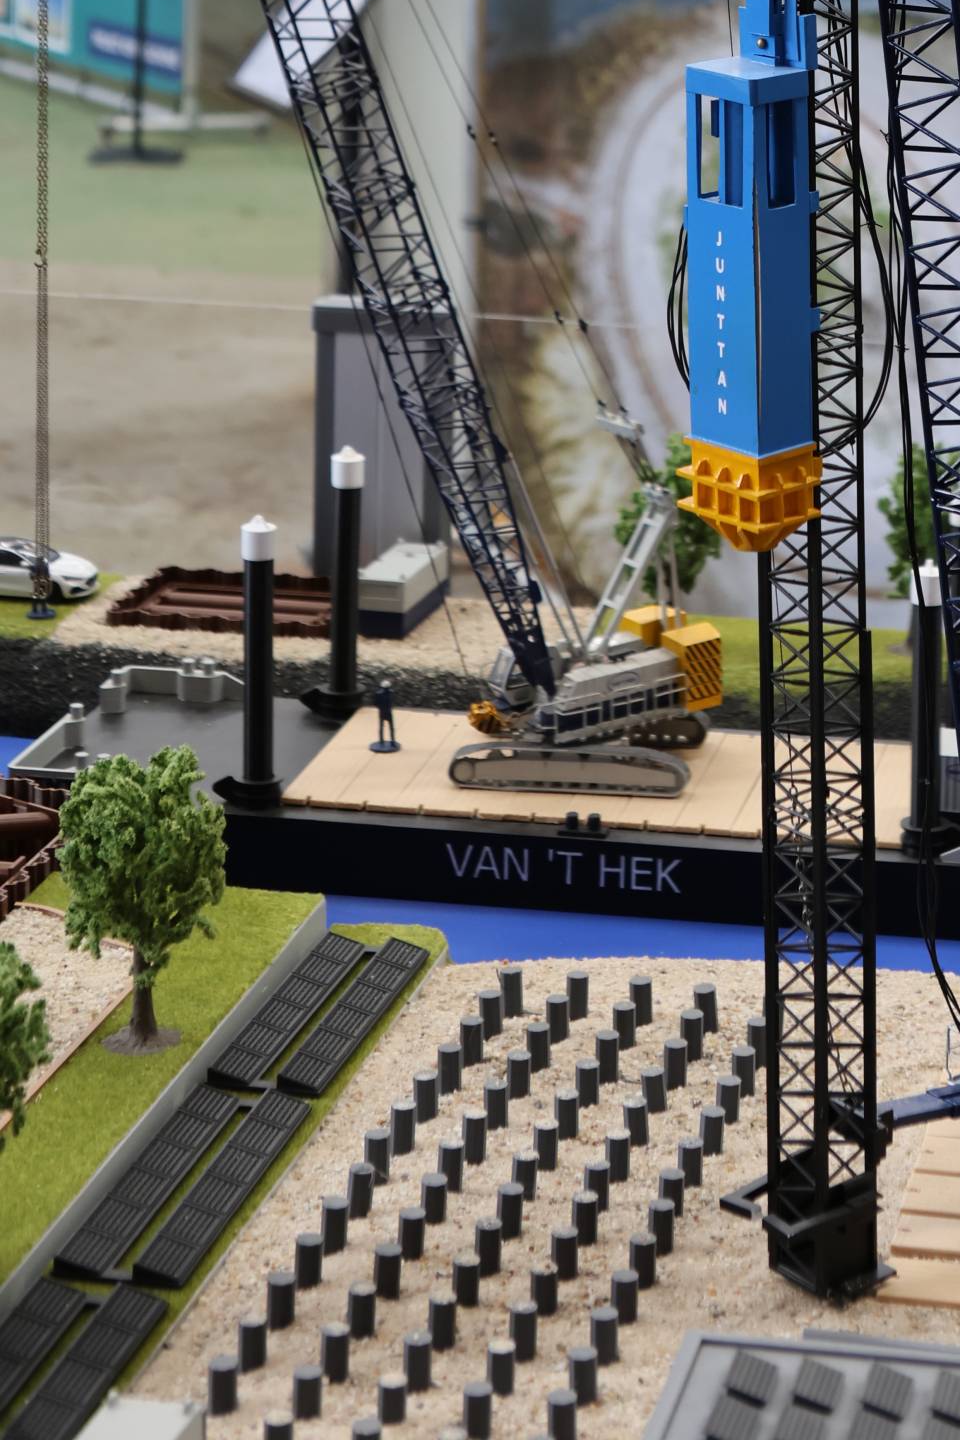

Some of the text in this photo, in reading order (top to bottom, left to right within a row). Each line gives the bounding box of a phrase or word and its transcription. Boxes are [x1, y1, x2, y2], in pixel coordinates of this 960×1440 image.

[715, 231, 727, 415] JUNTTAN
[446, 843, 682, 894] VAN 'T HEK
